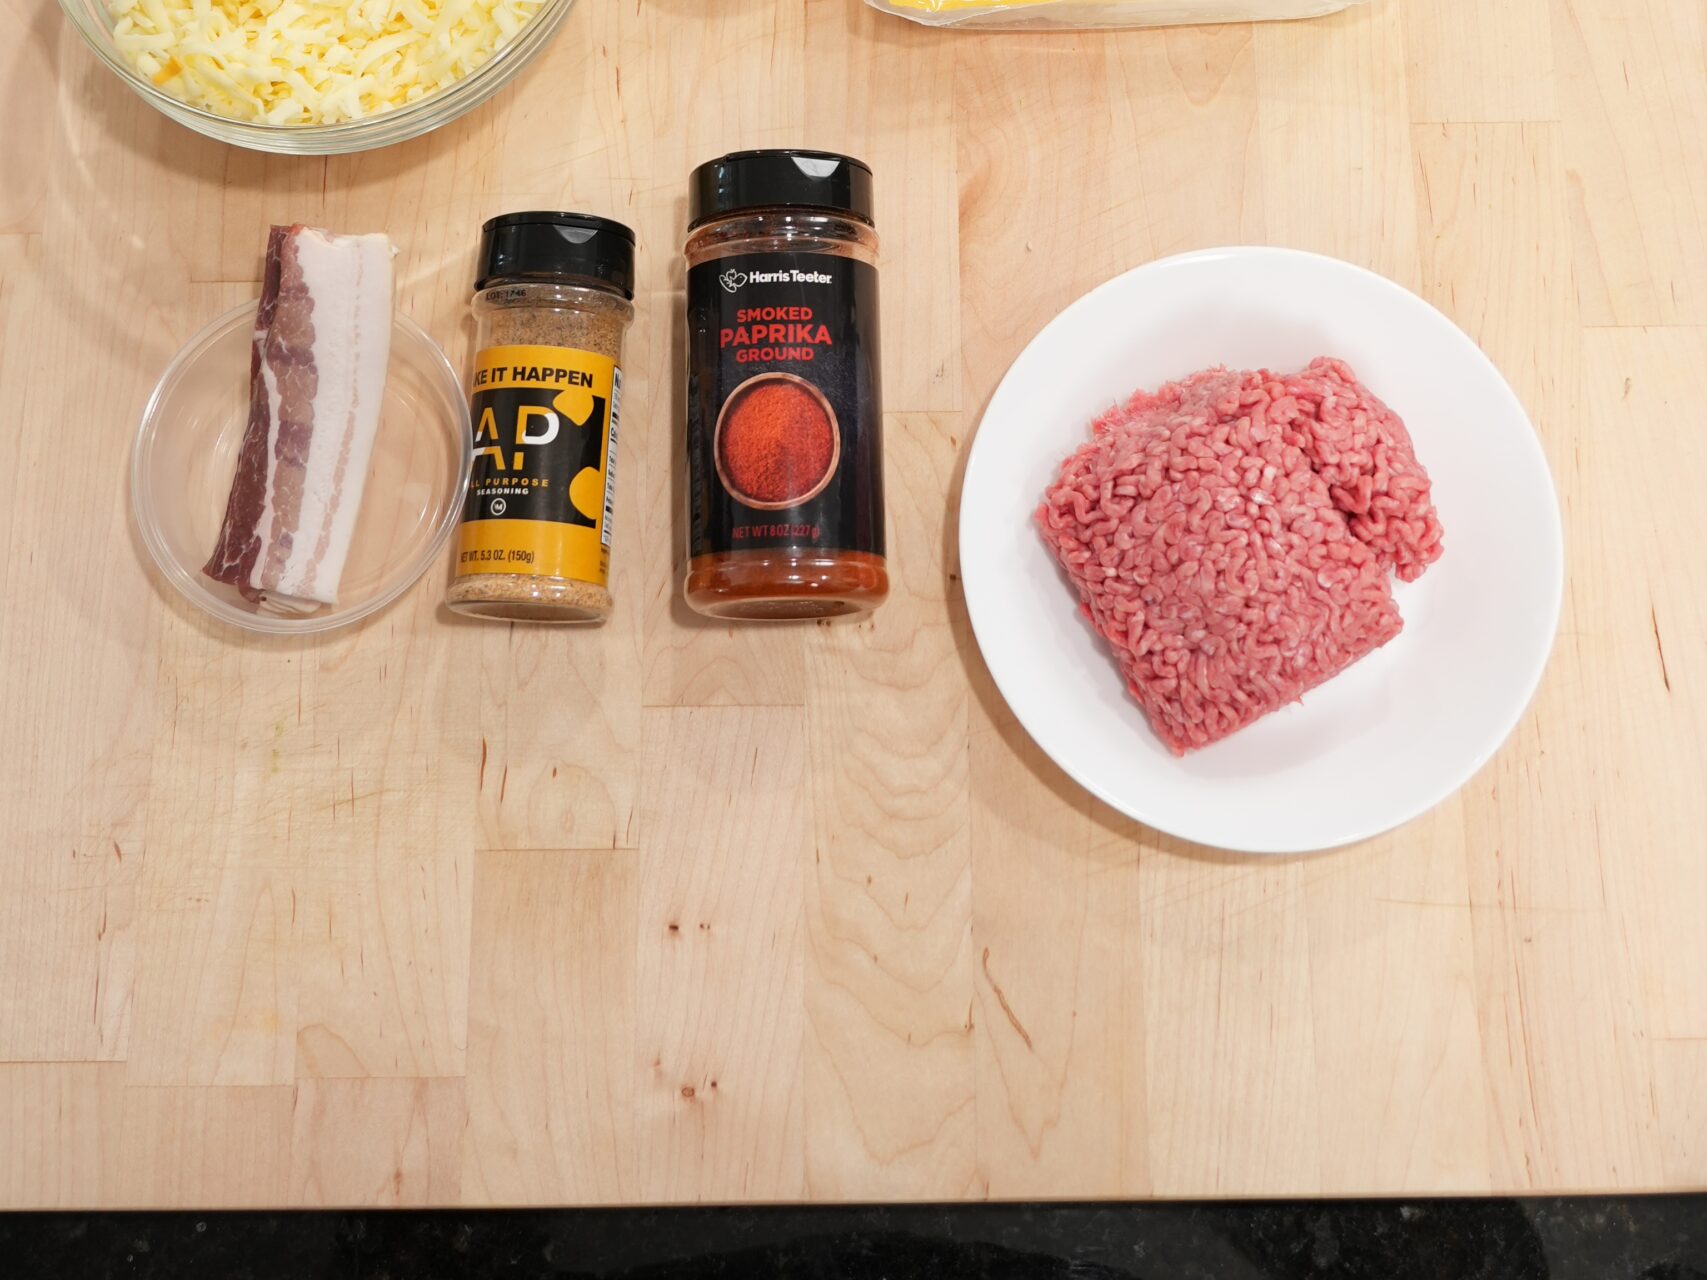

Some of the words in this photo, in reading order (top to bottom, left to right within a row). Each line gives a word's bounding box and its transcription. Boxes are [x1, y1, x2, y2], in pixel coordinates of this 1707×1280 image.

[749, 270, 790, 283] Harris
[789, 269, 832, 284] Teeter
[736, 306, 813, 323] SMOKED
[720, 323, 833, 349] PAPRIKA
[735, 346, 815, 364] GROUND
[491, 367, 508, 383] IT
[512, 366, 593, 389] HAPPEN
[485, 477, 550, 488] PURPOSE
[476, 487, 529, 496] SEASONING
[731, 526, 751, 539] NET
[751, 524, 769, 537] WT
[769, 525, 776, 536] 8
[776, 524, 790, 536] OZ
[468, 550, 480, 561] WT.
[480, 549, 492, 561] 5.3
[493, 549, 506, 561] OZ.
[508, 549, 535, 565] (150g)
